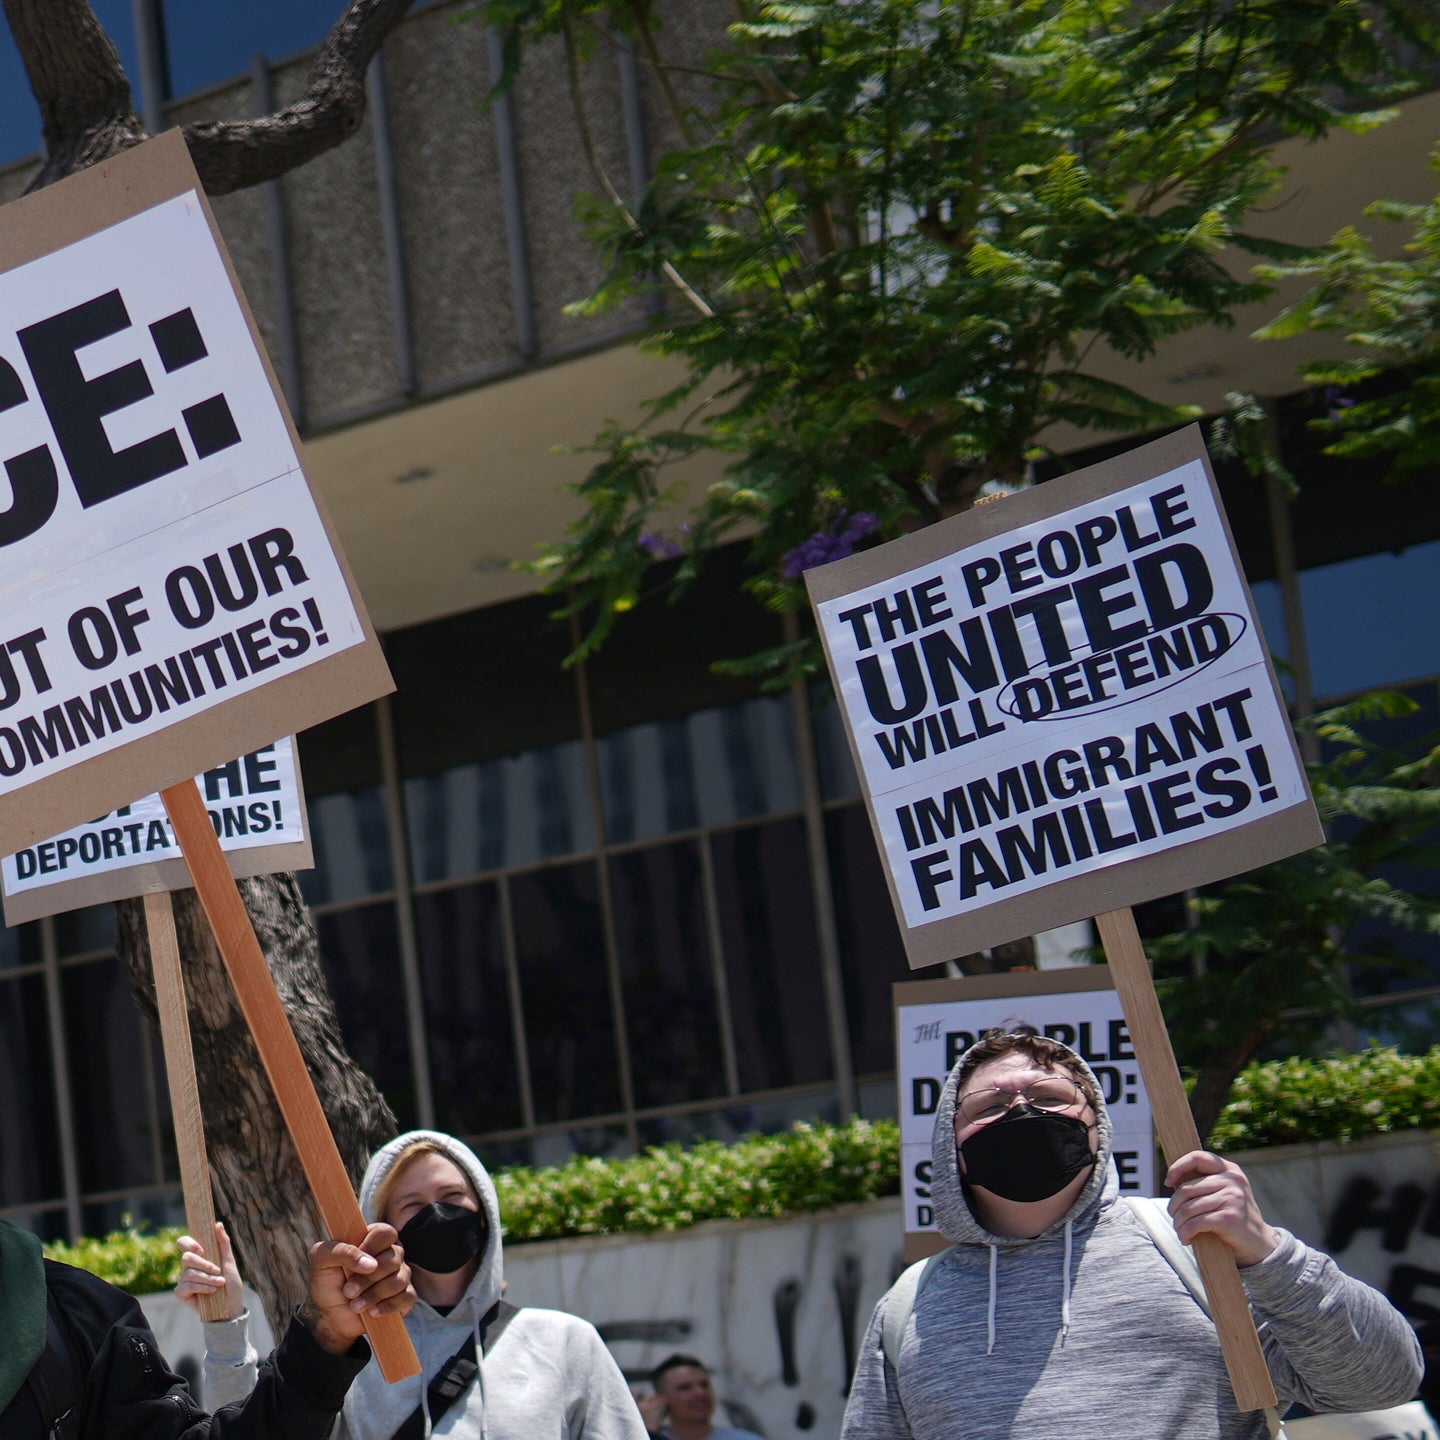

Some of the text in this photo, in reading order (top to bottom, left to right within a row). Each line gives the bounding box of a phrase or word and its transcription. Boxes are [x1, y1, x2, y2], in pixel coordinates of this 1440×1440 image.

[67, 587, 154, 670] OF
[165, 527, 310, 630] OUR
[839, 483, 1197, 651] THE PEOPLE
[856, 542, 1215, 726] UNITED
[874, 613, 1231, 770] WILL DEFEND
[895, 687, 1252, 851] IMMIGRANT
[15, 800, 284, 881] DEPORTAONS!
[204, 744, 281, 802] HE
[910, 744, 1279, 911] FAMILIES!
[913, 1019, 944, 1044] THE
